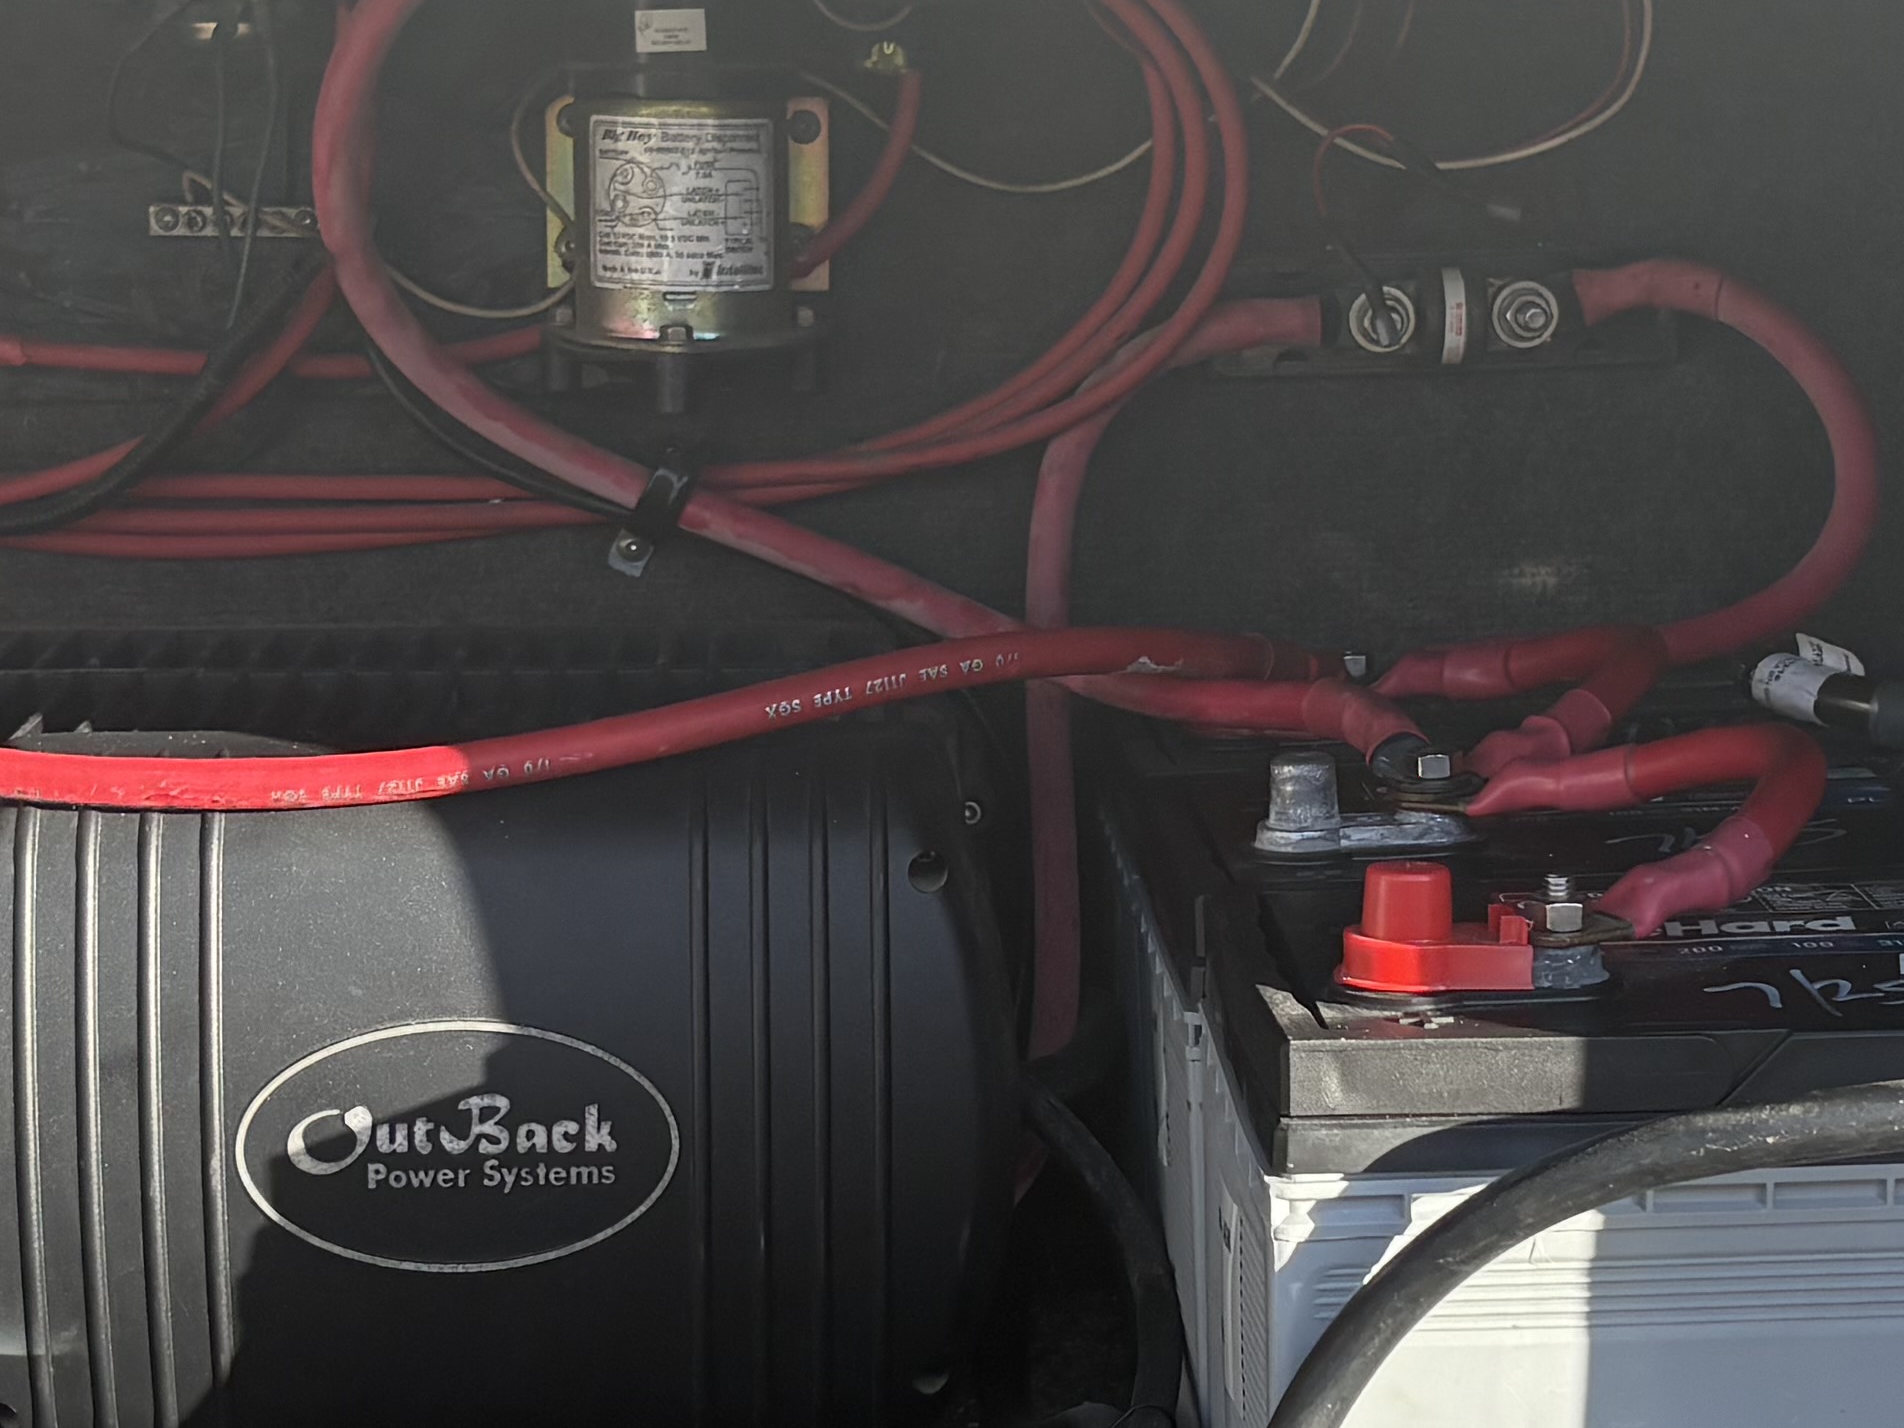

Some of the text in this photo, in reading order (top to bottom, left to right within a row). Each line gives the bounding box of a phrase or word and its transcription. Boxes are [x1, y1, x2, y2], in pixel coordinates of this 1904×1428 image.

[919, 664, 947, 681] SAE
[959, 659, 984, 673] GA
[865, 673, 907, 695] J1127
[813, 686, 852, 708] TYPE
[765, 699, 801, 719] SGX
[1649, 915, 1856, 938] Hard
[1792, 940, 1834, 949] 100
[287, 1093, 618, 1176] OutBack
[367, 1158, 616, 1194] Power Systems
